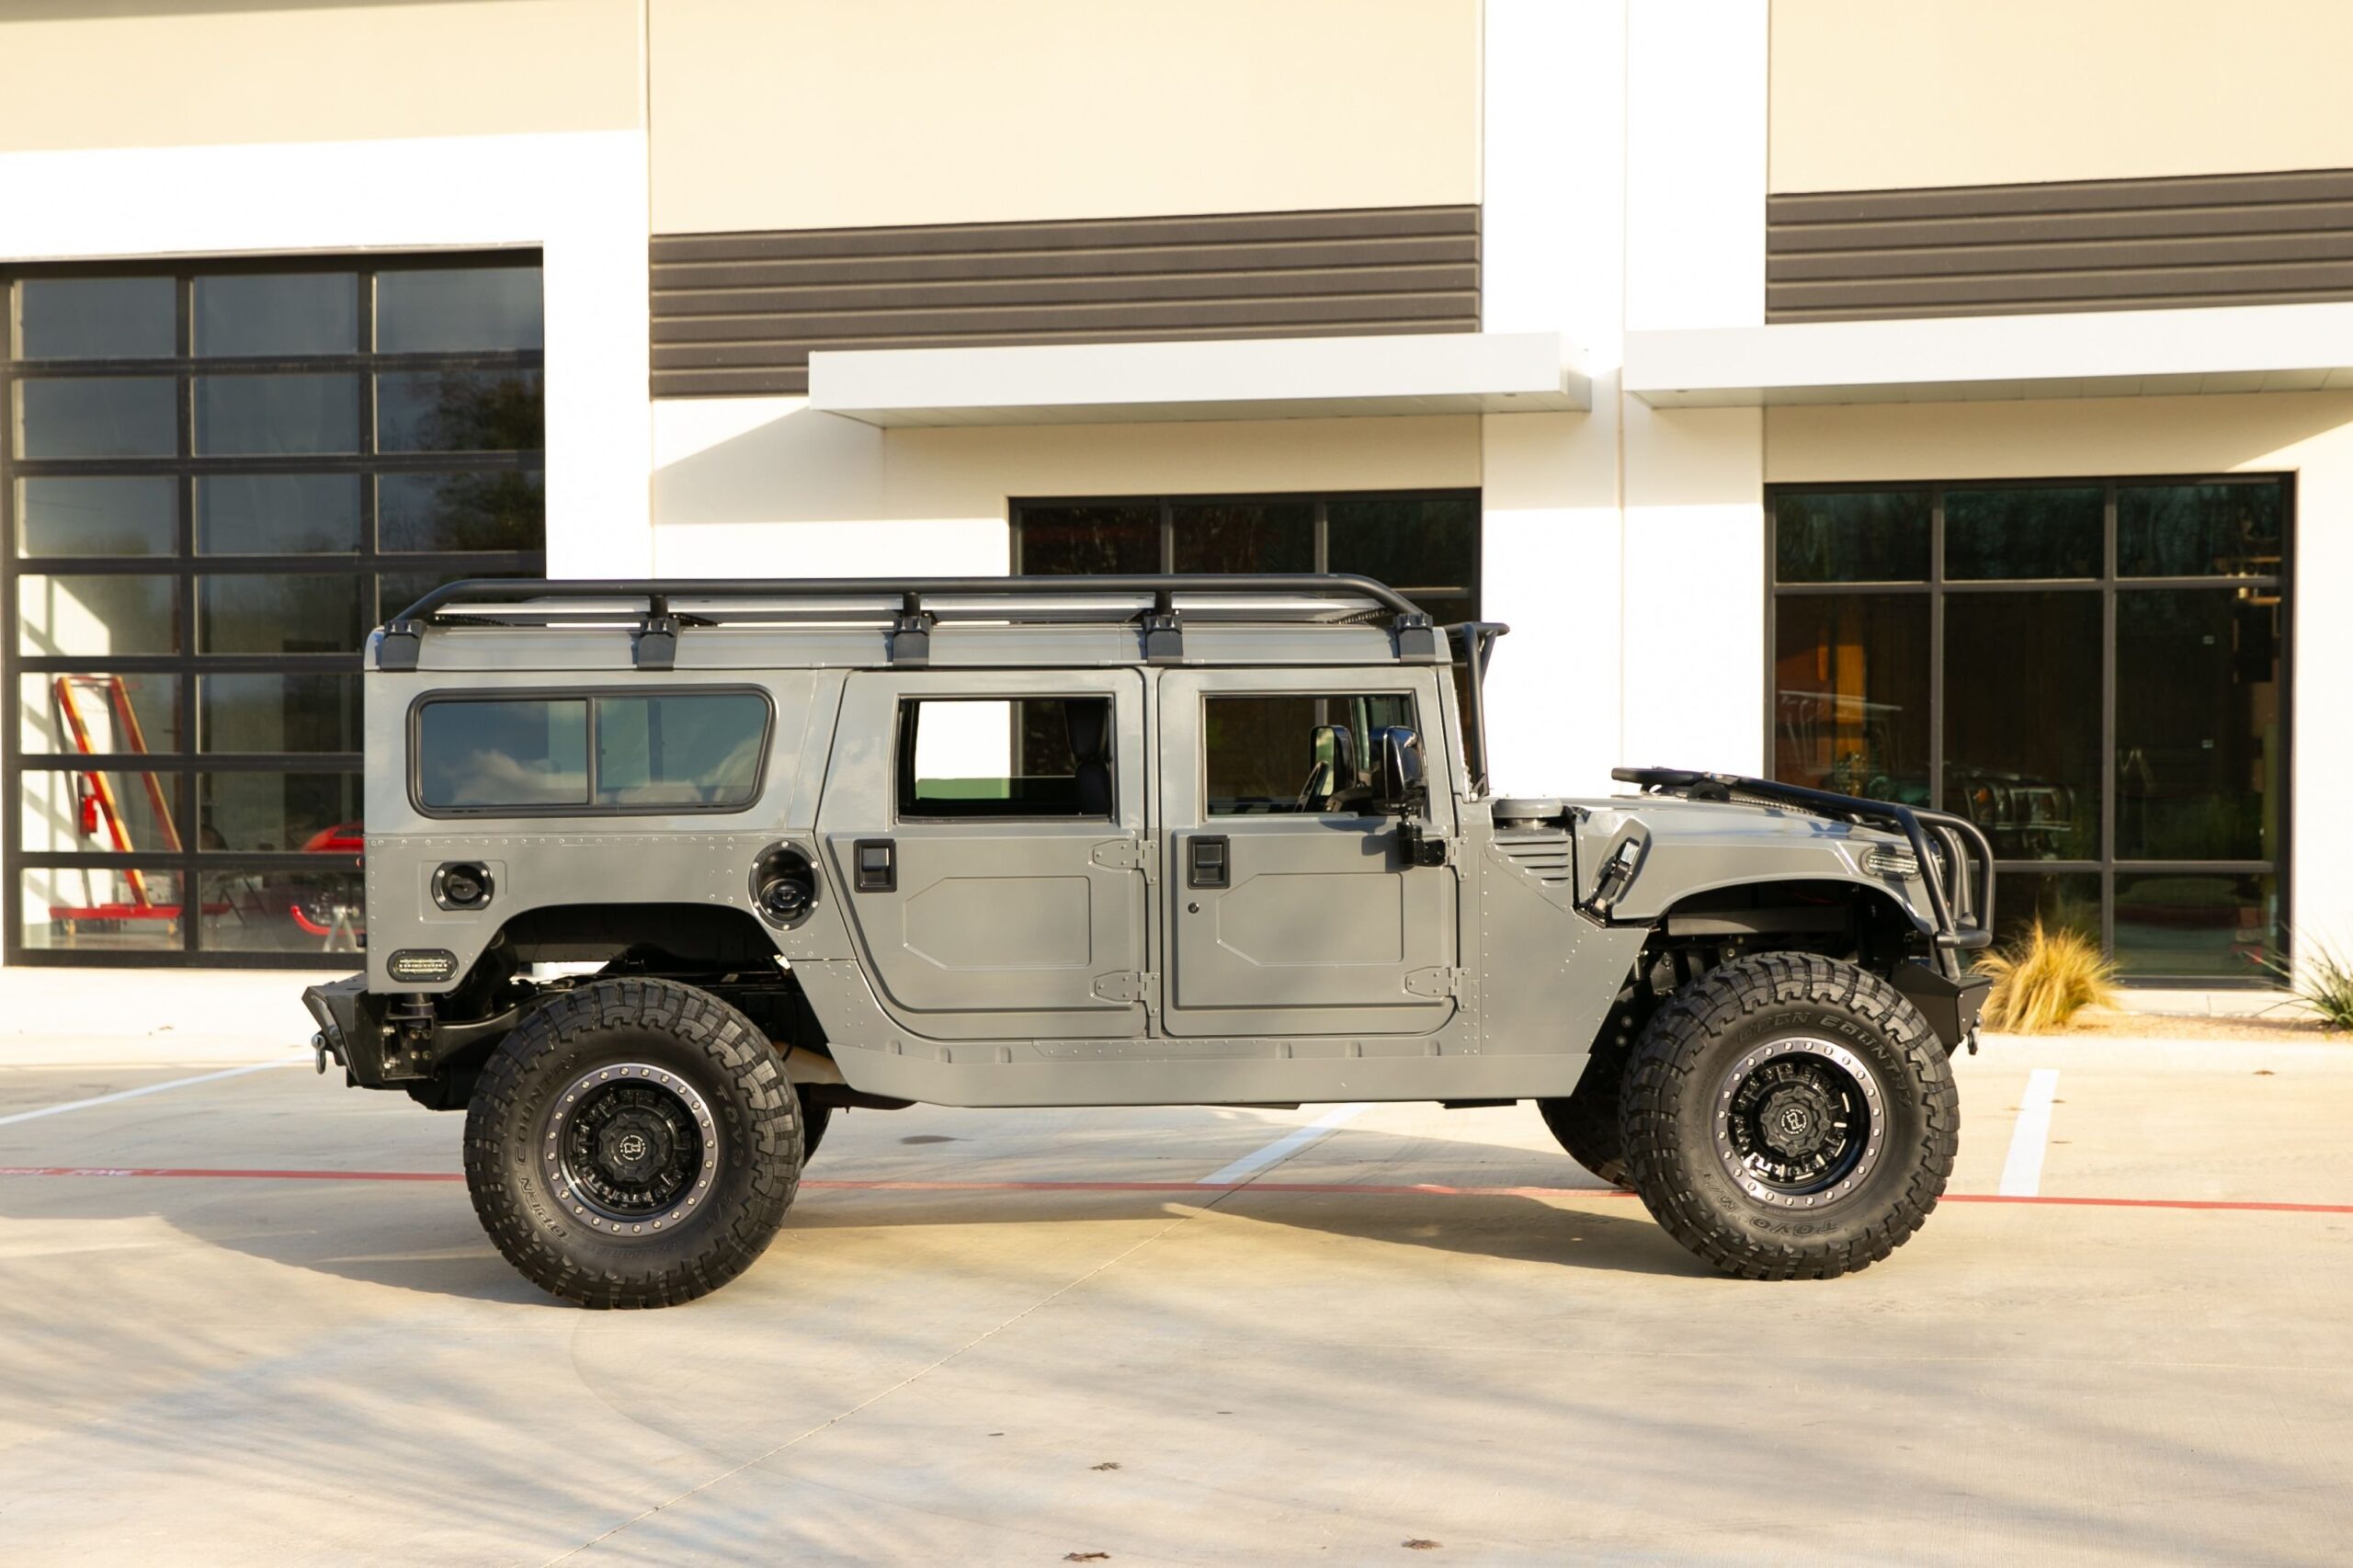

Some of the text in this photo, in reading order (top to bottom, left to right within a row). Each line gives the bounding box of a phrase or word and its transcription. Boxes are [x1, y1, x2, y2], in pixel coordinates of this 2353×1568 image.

[1819, 1014, 1914, 1109] COUNTRY
[716, 1084, 745, 1167] TOYO
[518, 1176, 568, 1240] OPEN
[1749, 1215, 1838, 1236] TOYO
